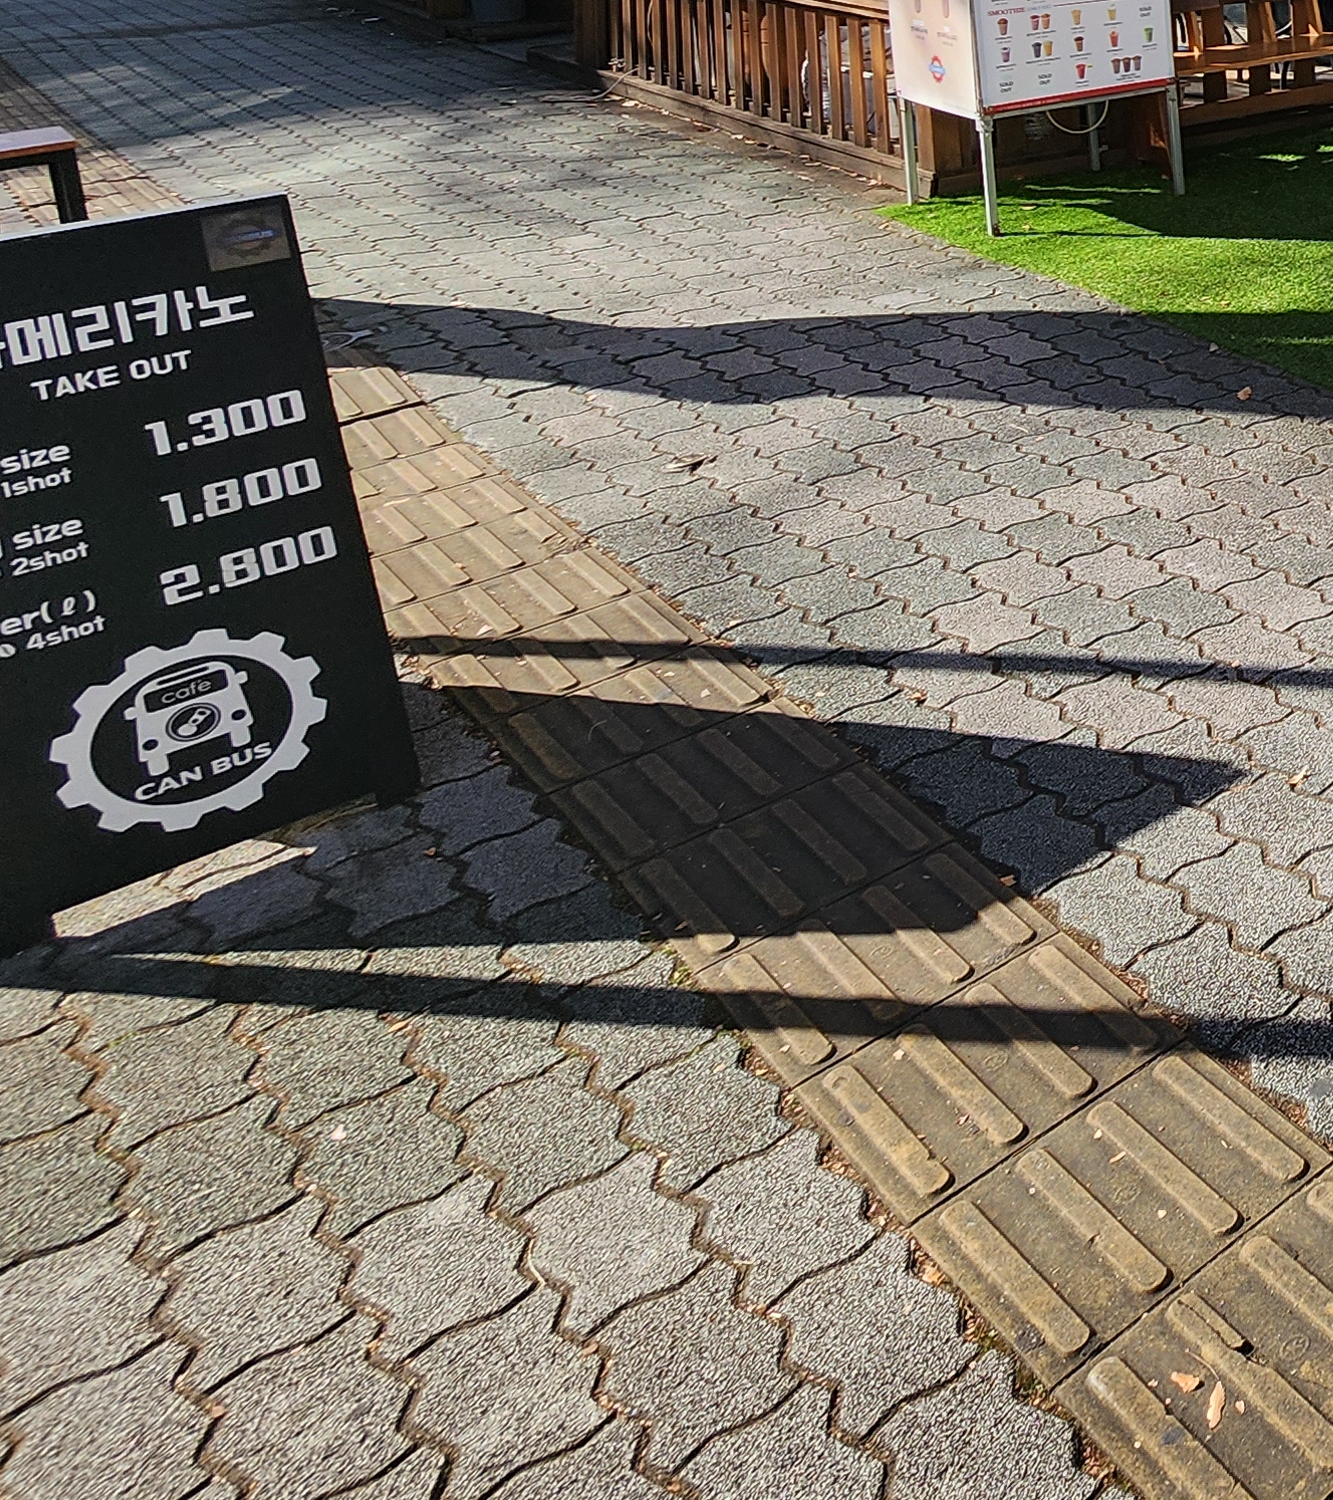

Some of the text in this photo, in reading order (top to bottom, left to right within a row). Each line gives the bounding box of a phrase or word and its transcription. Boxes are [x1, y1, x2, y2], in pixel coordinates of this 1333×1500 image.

[0, 286, 255, 368] 메리카노
[30, 349, 192, 401] TAKE OUT
[144, 389, 307, 456] 1.300
[159, 457, 323, 528] 1.800
[9, 541, 90, 577] 2shot
[158, 525, 339, 606] 2.800
[26, 615, 107, 651] 4shot
[134, 741, 274, 802] CAN BUS
